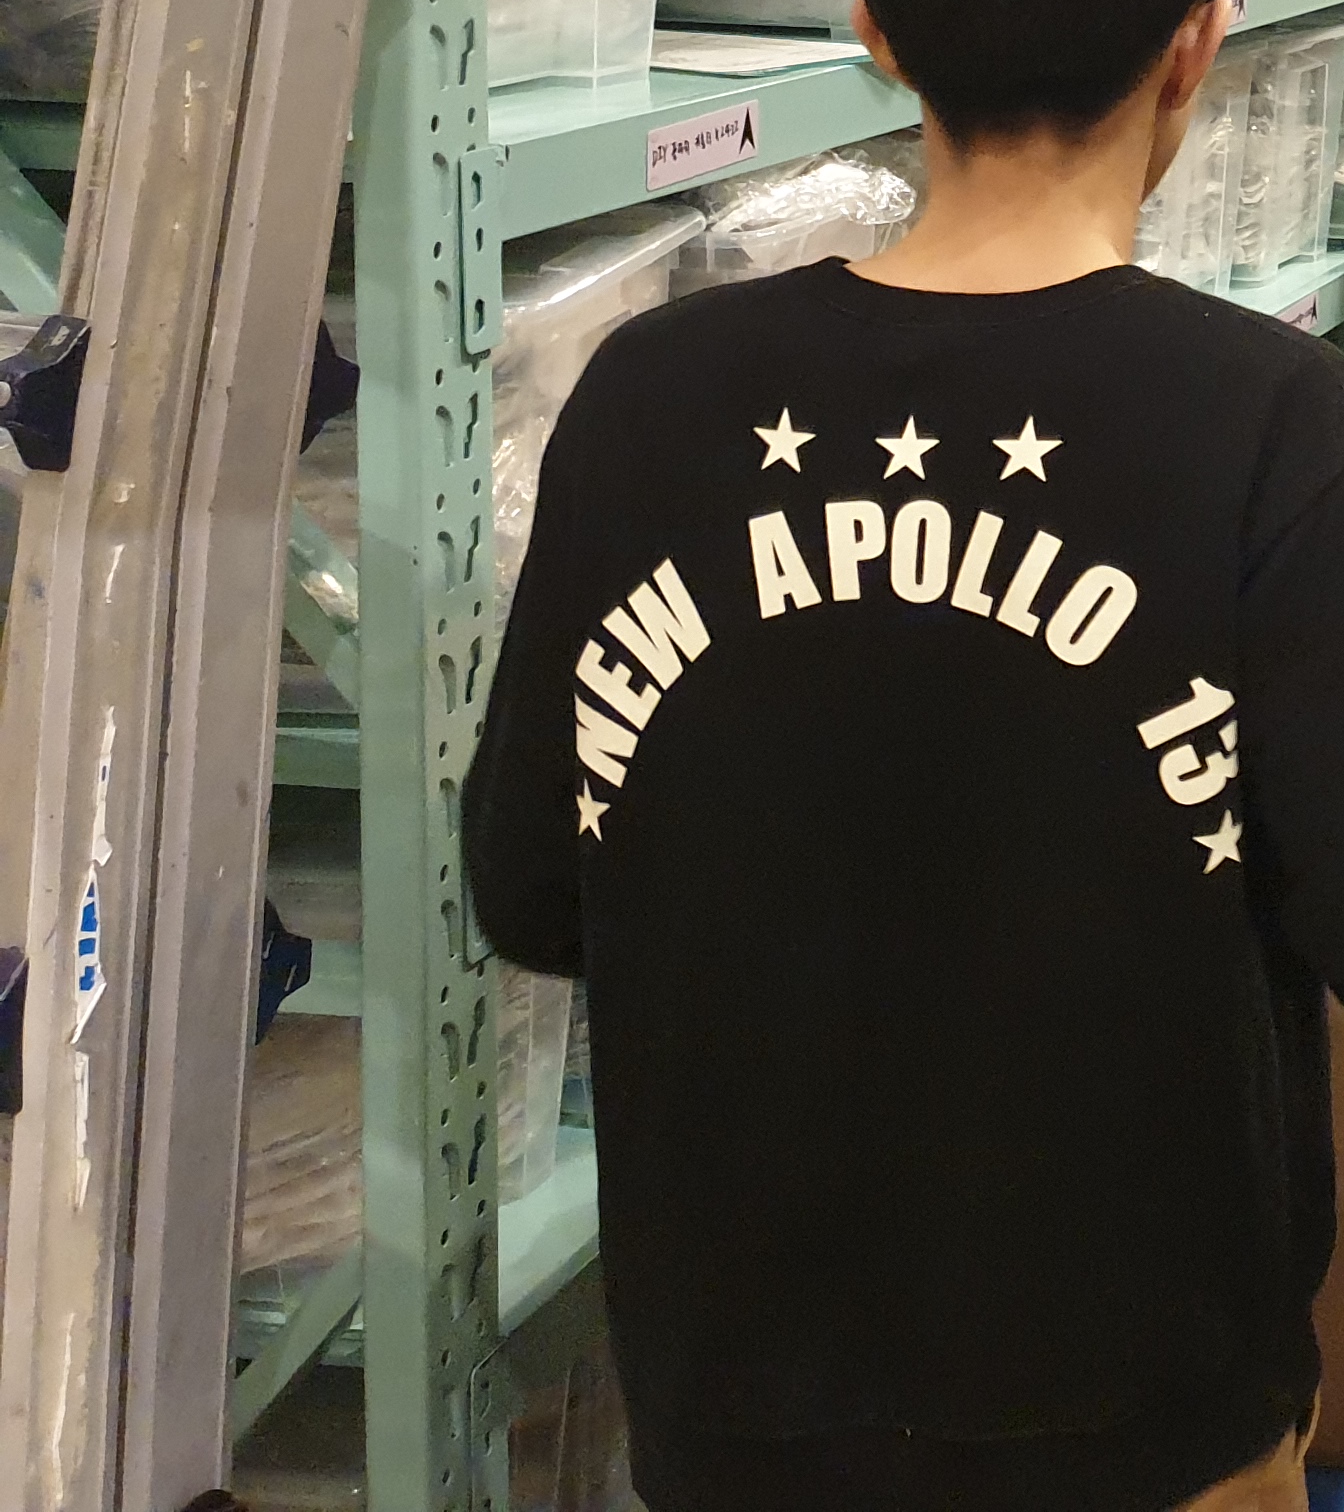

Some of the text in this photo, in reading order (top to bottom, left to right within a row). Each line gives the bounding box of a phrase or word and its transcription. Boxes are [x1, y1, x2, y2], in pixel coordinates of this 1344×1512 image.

[652, 144, 668, 168] DIY
[574, 499, 1240, 805] NEW APOLLO 13
